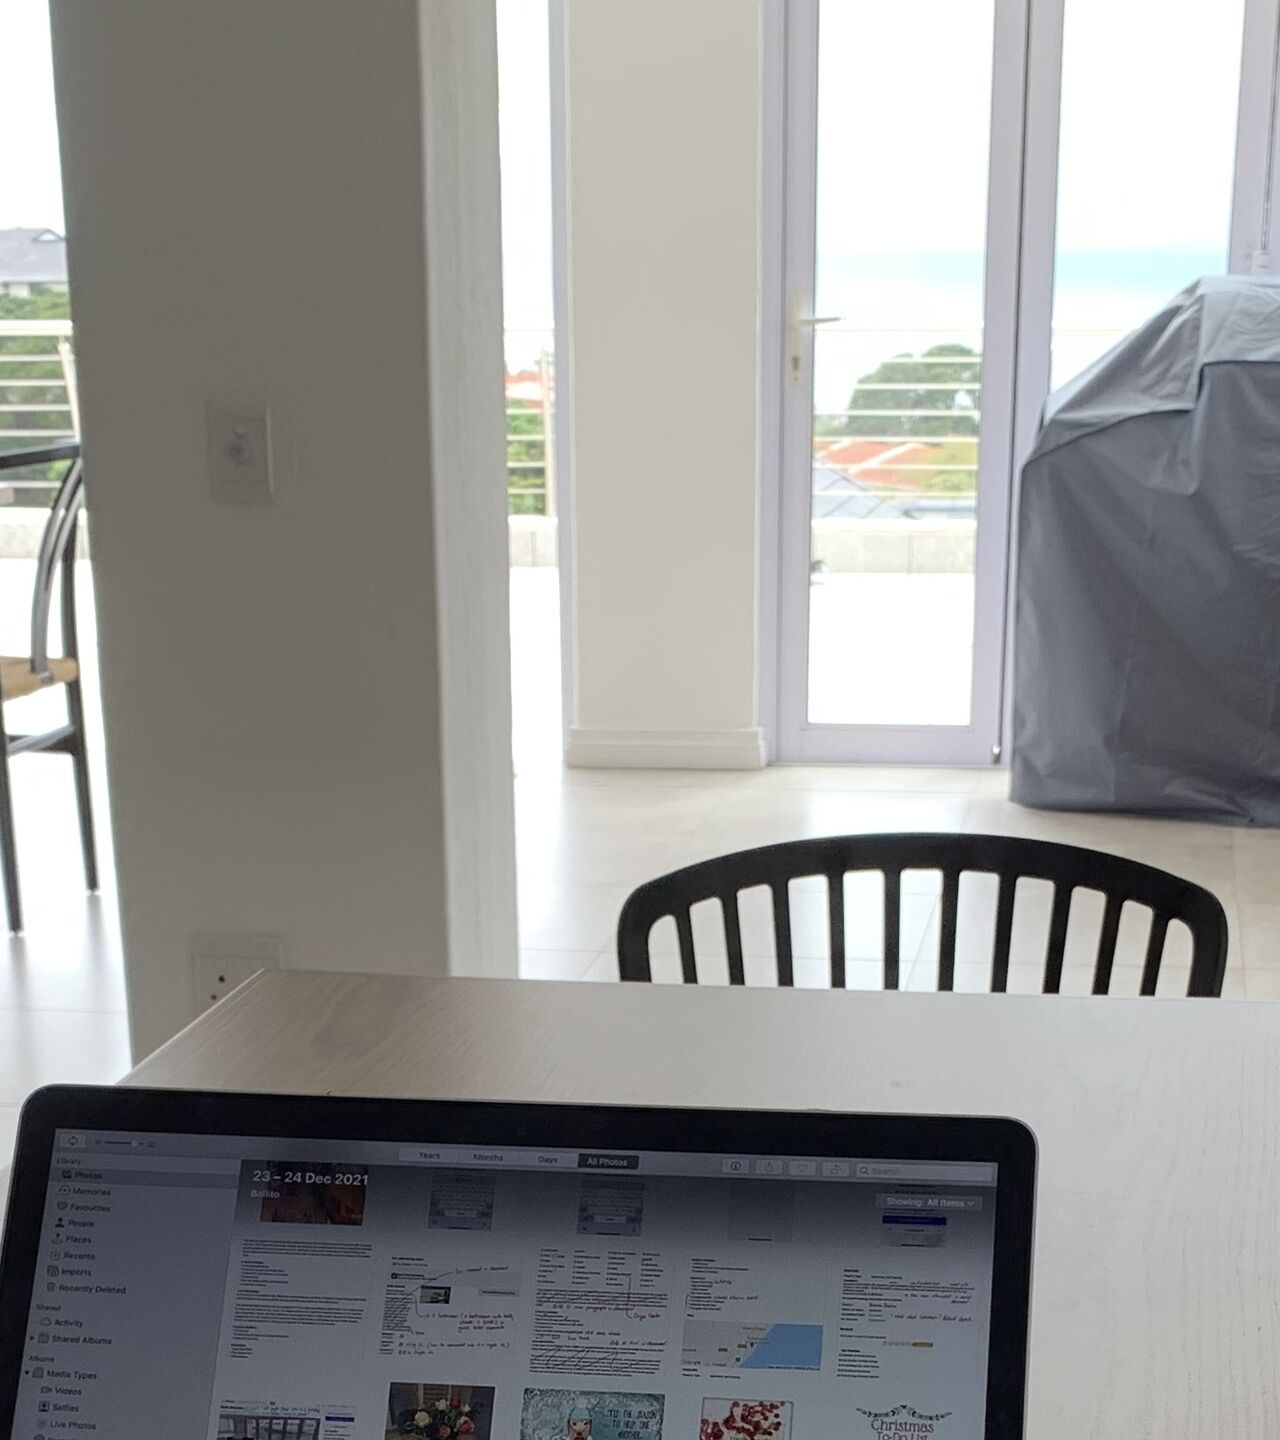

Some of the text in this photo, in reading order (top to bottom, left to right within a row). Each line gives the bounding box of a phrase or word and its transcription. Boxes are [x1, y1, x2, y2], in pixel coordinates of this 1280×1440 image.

[419, 1151, 628, 1168] Years Months Days All Photos
[74, 1172, 103, 1180] Photos
[252, 1171, 271, 1182] 23
[284, 1172, 302, 1183] 24
[305, 1173, 331, 1185] Dec
[335, 1174, 369, 1186] 2021
[73, 1188, 111, 1196] Memories
[250, 1189, 280, 1199] Ballito
[70, 1203, 110, 1213] Favourites
[927, 1198, 938, 1206] All
[940, 1199, 966, 1208] Items
[68, 1220, 95, 1229] People
[66, 1236, 92, 1244] Places
[63, 1252, 95, 1260] Recents
[61, 1268, 92, 1278] Imports
[58, 1284, 126, 1294] Recently Deleted
[35, 1303, 61, 1312] Shared
[54, 1319, 84, 1329] Activity
[51, 1335, 112, 1345] Shared Albums
[29, 1355, 55, 1363] Albums
[47, 1370, 97, 1381] Media Types
[55, 1387, 82, 1396] Videos
[52, 1403, 79, 1412] Selfies
[50, 1420, 97, 1430] Live Photos
[871, 1418, 934, 1433] Christmas
